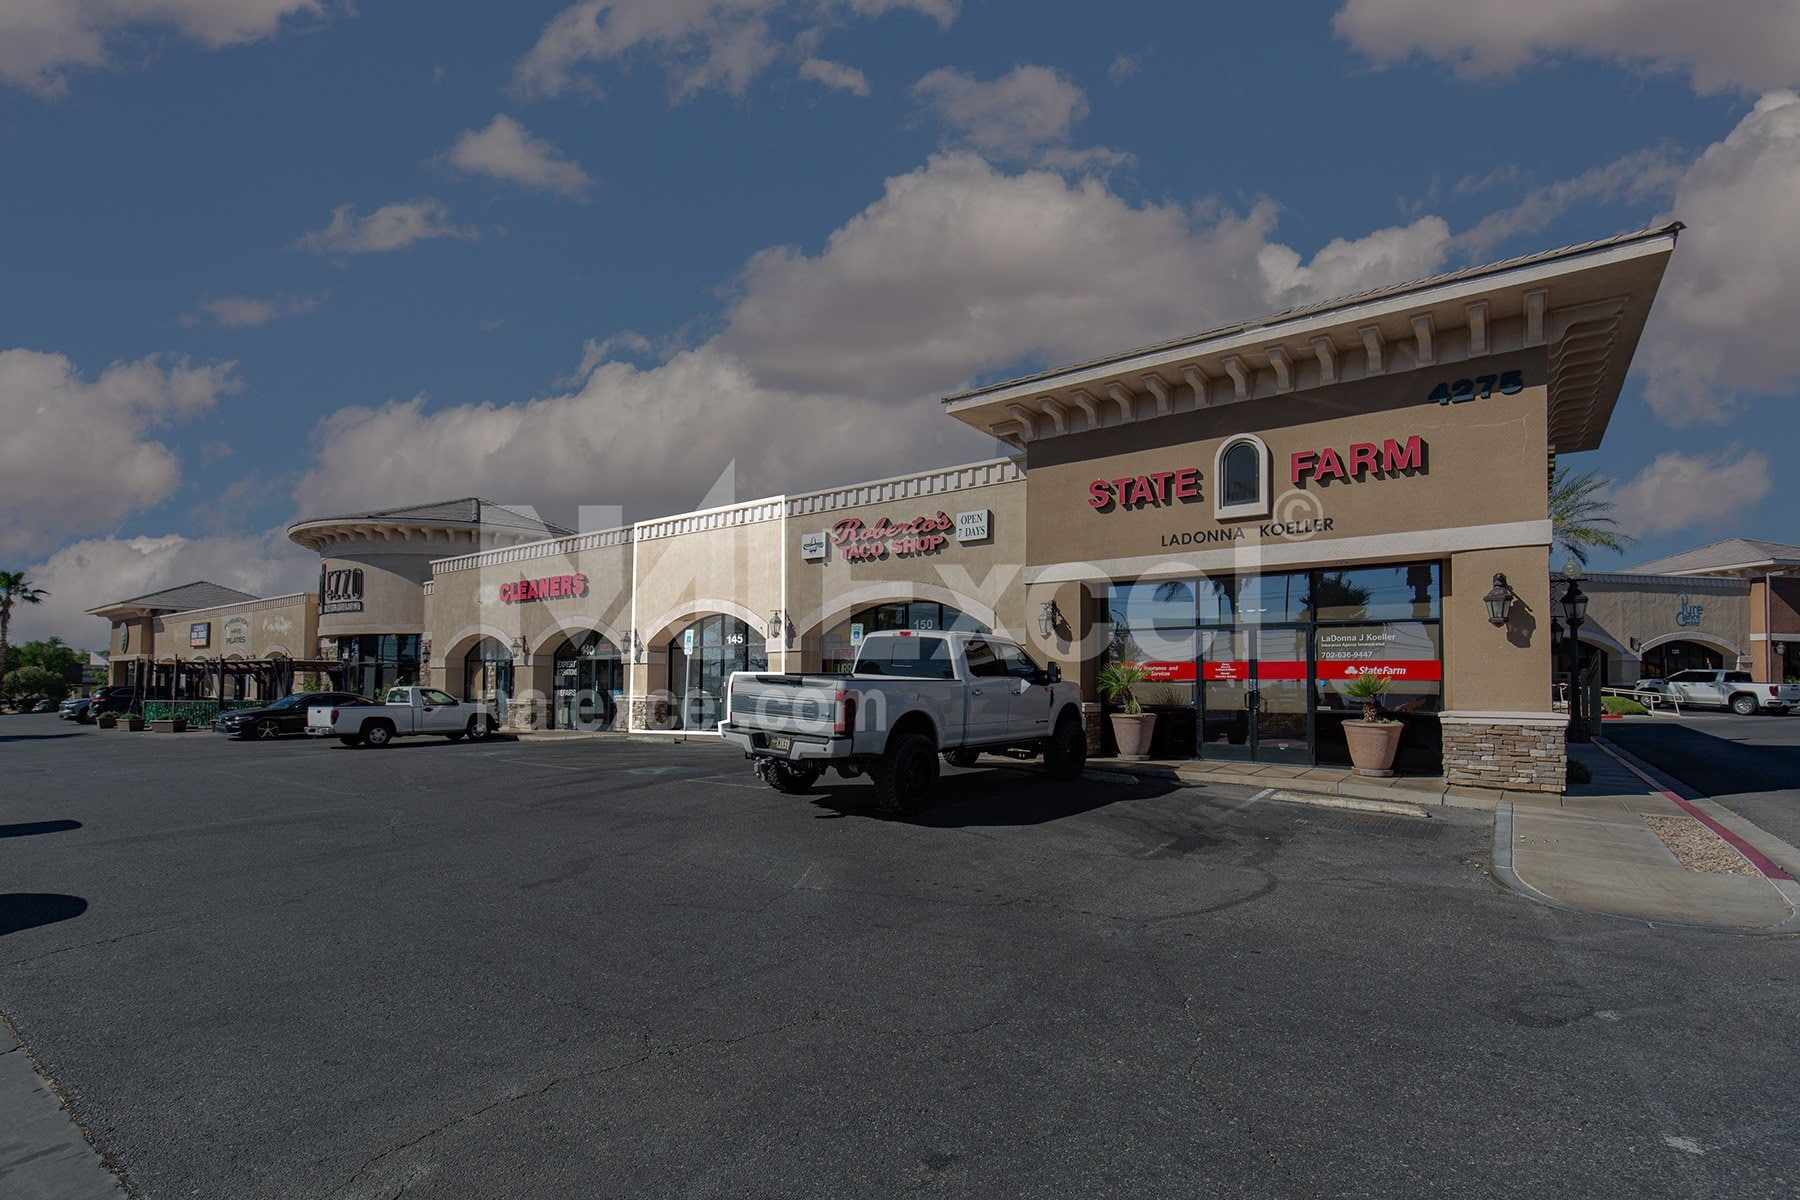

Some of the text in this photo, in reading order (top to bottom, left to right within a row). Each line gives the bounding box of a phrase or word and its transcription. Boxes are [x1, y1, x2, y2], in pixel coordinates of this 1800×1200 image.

[1428, 369, 1524, 406] 4275
[1088, 435, 1423, 509] STATE FARM
[829, 511, 951, 545] Roberto's
[960, 513, 984, 525] OPEN
[957, 527, 986, 538] 7 DAYS
[1161, 518, 1334, 547] LADONNA KOELLER
[841, 535, 944, 560] TACO SHOP
[500, 573, 587, 603] CLEANERS
[913, 619, 933, 630] 150
[726, 633, 744, 645] 145
[1321, 632, 1396, 642] LaDonna J Koeller
[1321, 651, 1373, 659] 702-636-9447
